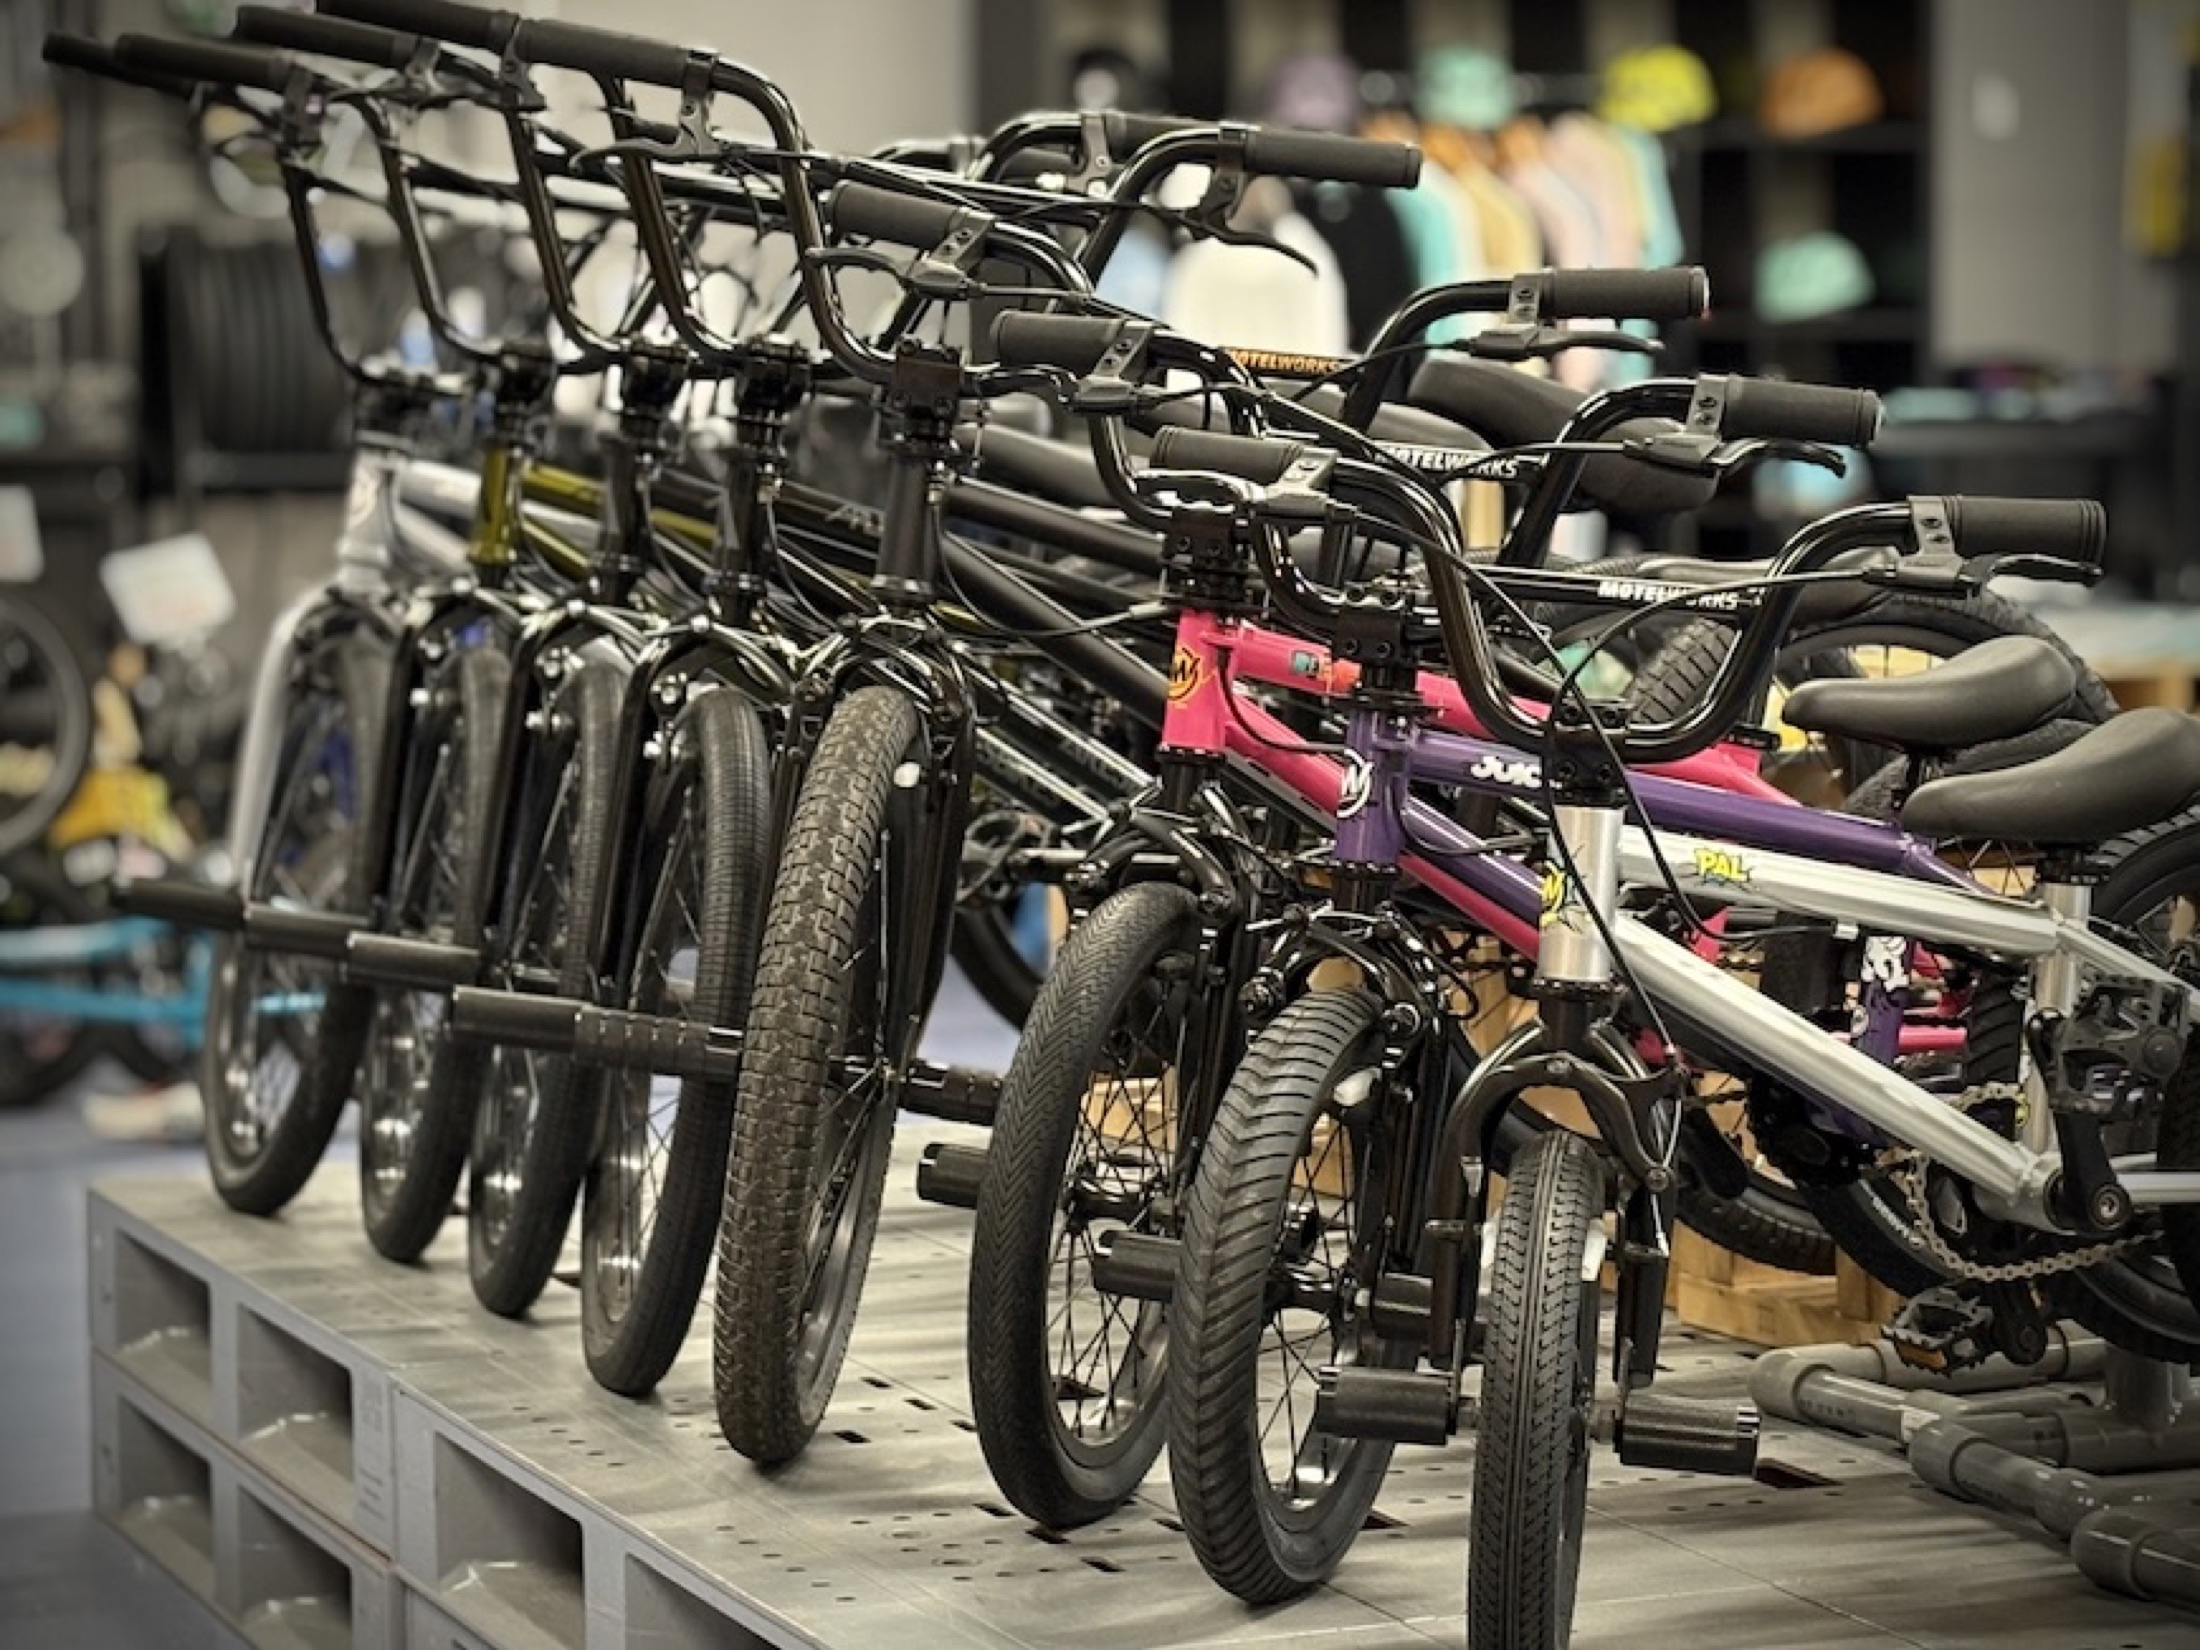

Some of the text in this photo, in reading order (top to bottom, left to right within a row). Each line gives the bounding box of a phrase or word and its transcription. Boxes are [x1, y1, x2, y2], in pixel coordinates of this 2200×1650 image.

[1231, 349, 1340, 374] OTELWORKS
[1597, 579, 1738, 610] MOTELWRKS
[1694, 849, 1748, 882] PAL
